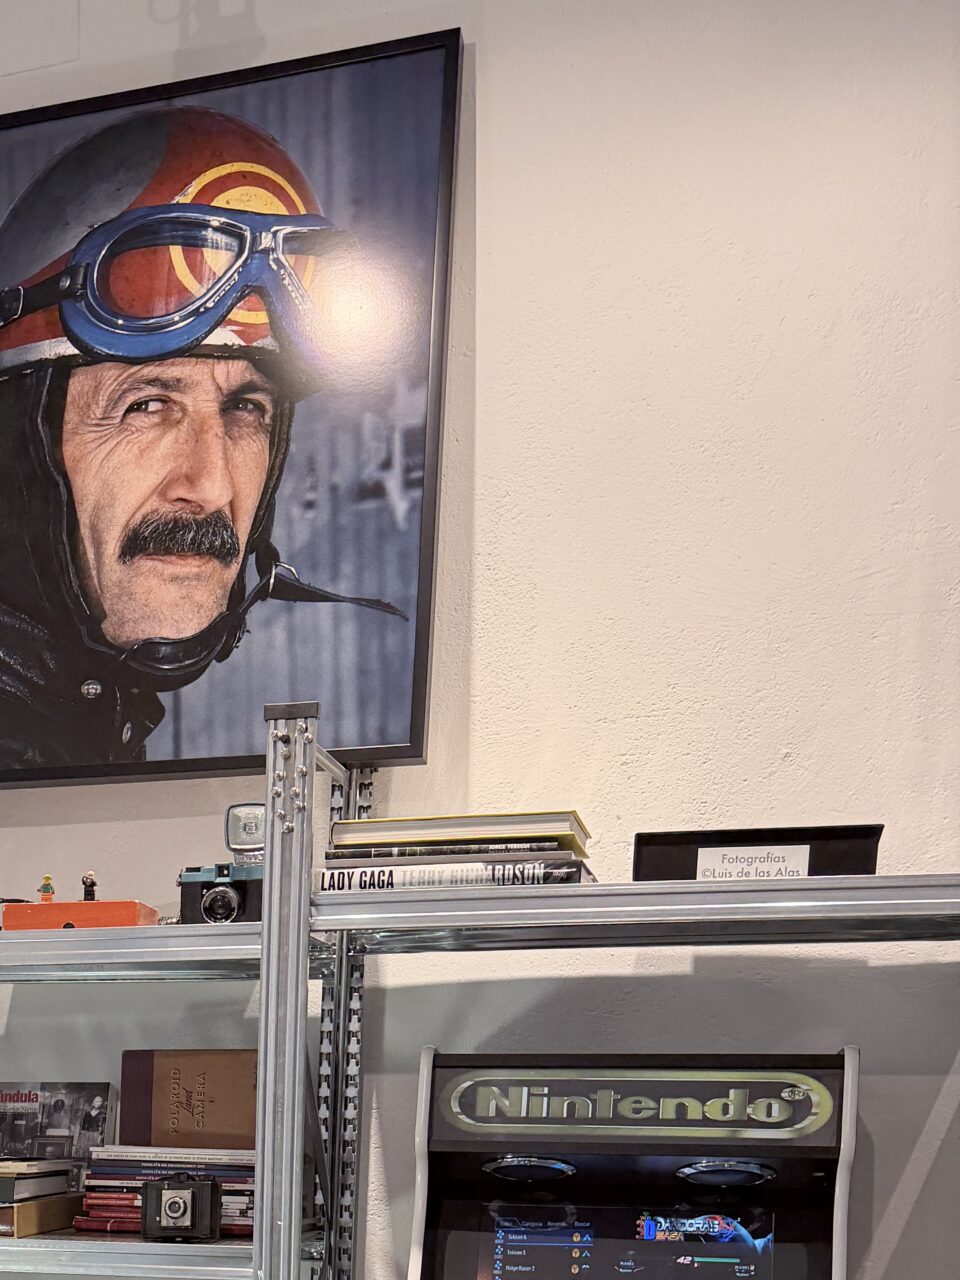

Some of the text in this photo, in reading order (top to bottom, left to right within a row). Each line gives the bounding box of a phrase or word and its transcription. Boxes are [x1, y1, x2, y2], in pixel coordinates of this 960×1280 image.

[721, 852, 786, 866] Fotografías
[736, 867, 751, 878] de
[755, 867, 771, 878] las
[774, 866, 801, 878] Alas
[321, 862, 545, 892] LADY GAGA TERRY RICHARDSON
[170, 1067, 181, 1135] POLAROID
[196, 1072, 207, 1129] CAMERA
